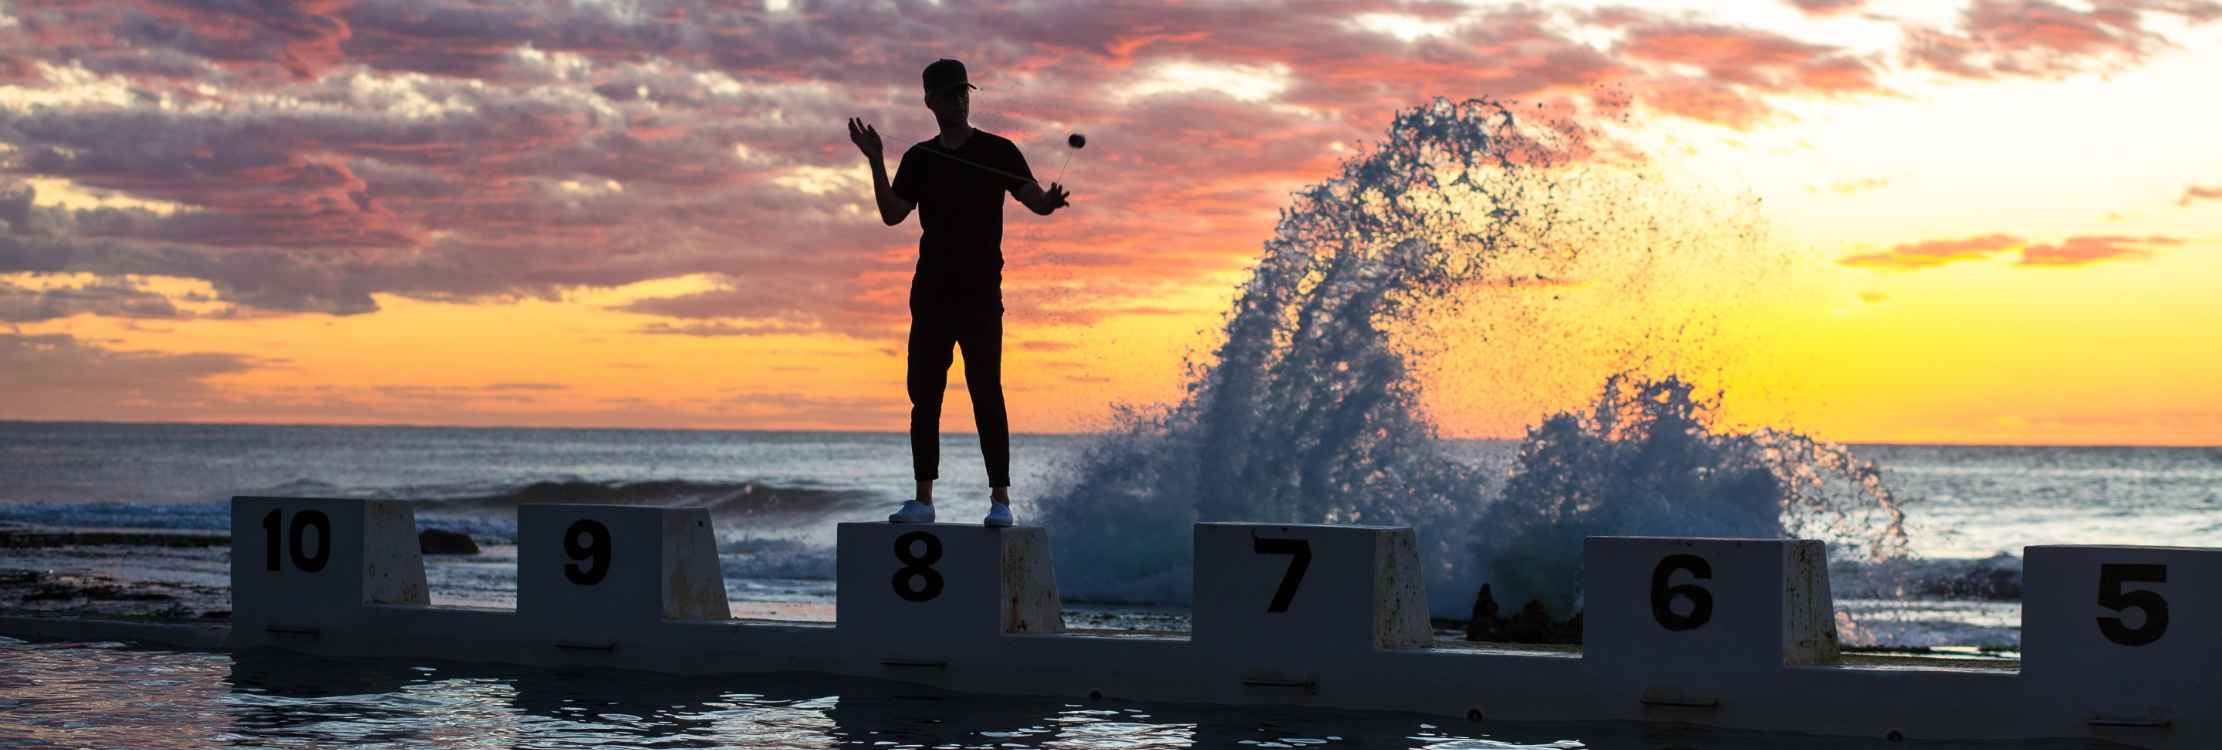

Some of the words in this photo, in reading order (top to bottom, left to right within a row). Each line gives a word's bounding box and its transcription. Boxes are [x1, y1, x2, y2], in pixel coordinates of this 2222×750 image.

[262, 508, 331, 574] 10
[563, 518, 612, 586] 9
[891, 531, 944, 603] 8
[1253, 536, 1313, 613] 7
[1650, 553, 1714, 632] 6
[2095, 563, 2169, 648] 5
